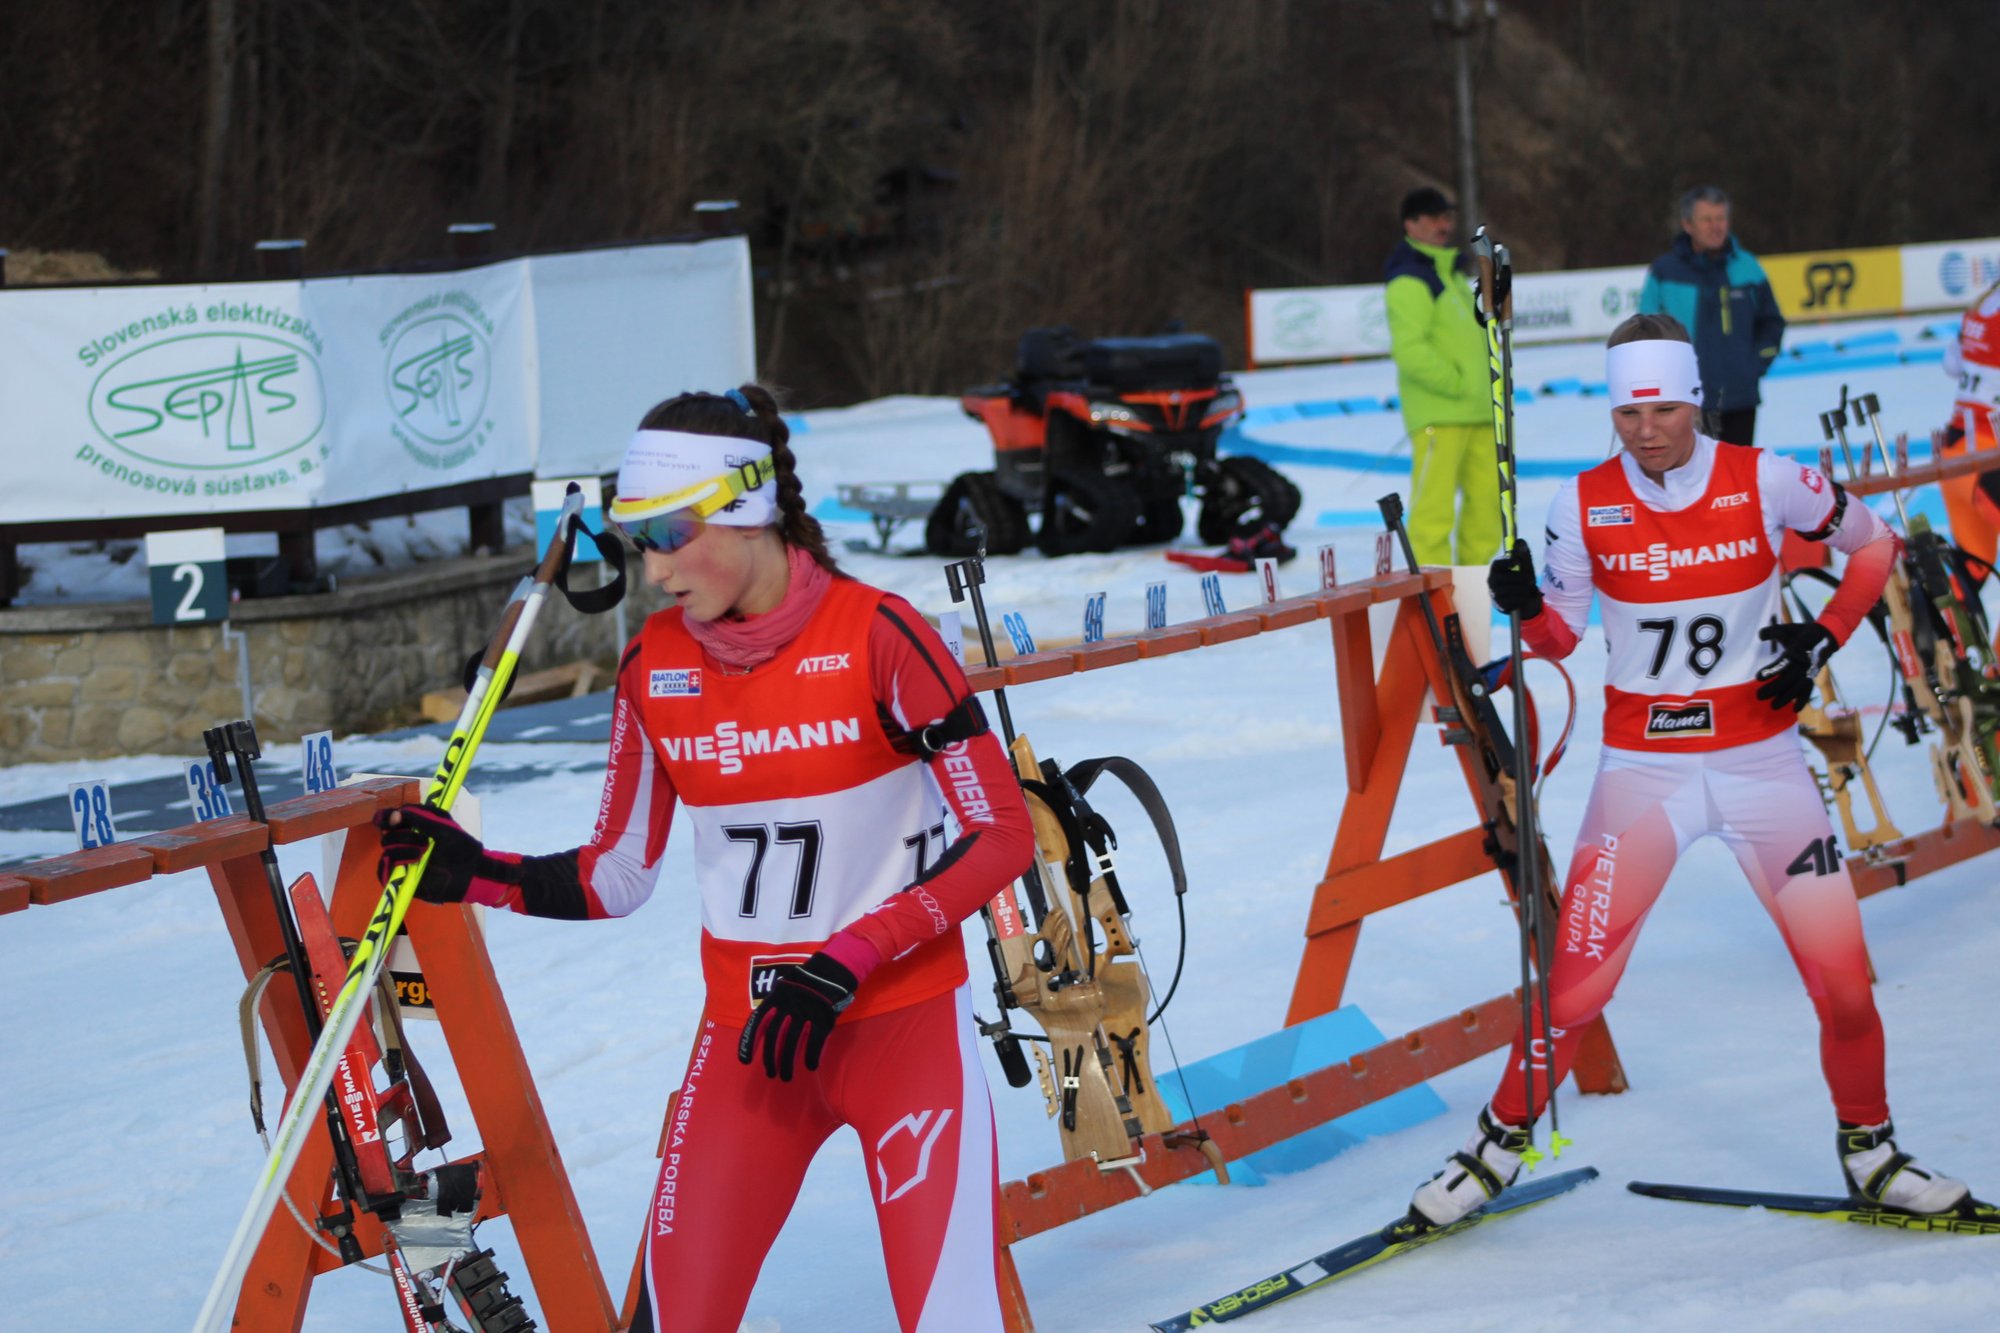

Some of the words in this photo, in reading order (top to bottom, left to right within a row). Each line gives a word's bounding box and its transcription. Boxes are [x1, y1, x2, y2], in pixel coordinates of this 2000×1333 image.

[78, 303, 198, 367] Slovenská
[76, 443, 196, 496] prenosová
[1710, 491, 1750, 510] ATEX
[173, 563, 206, 620] 2
[1264, 562, 1275, 603] 9
[795, 652, 850, 675] ATEX
[1637, 613, 1726, 680] 78
[651, 672, 689, 682] BIATLON
[660, 717, 861, 775] VIESSMANN
[1651, 711, 1706, 729] Hamé
[190, 761, 227, 821] 38
[306, 736, 336, 795] 48
[74, 785, 115, 849] 28
[721, 820, 823, 919] 77
[1585, 832, 1619, 960] PIETRZAK
[997, 891, 1014, 936] VIESSMA
[1566, 883, 1587, 954] GRUPA
[671, 1035, 712, 1148] SZKLARSKA
[657, 1153, 680, 1236] PORĘBA
[1209, 1273, 1290, 1317] FISCHER
